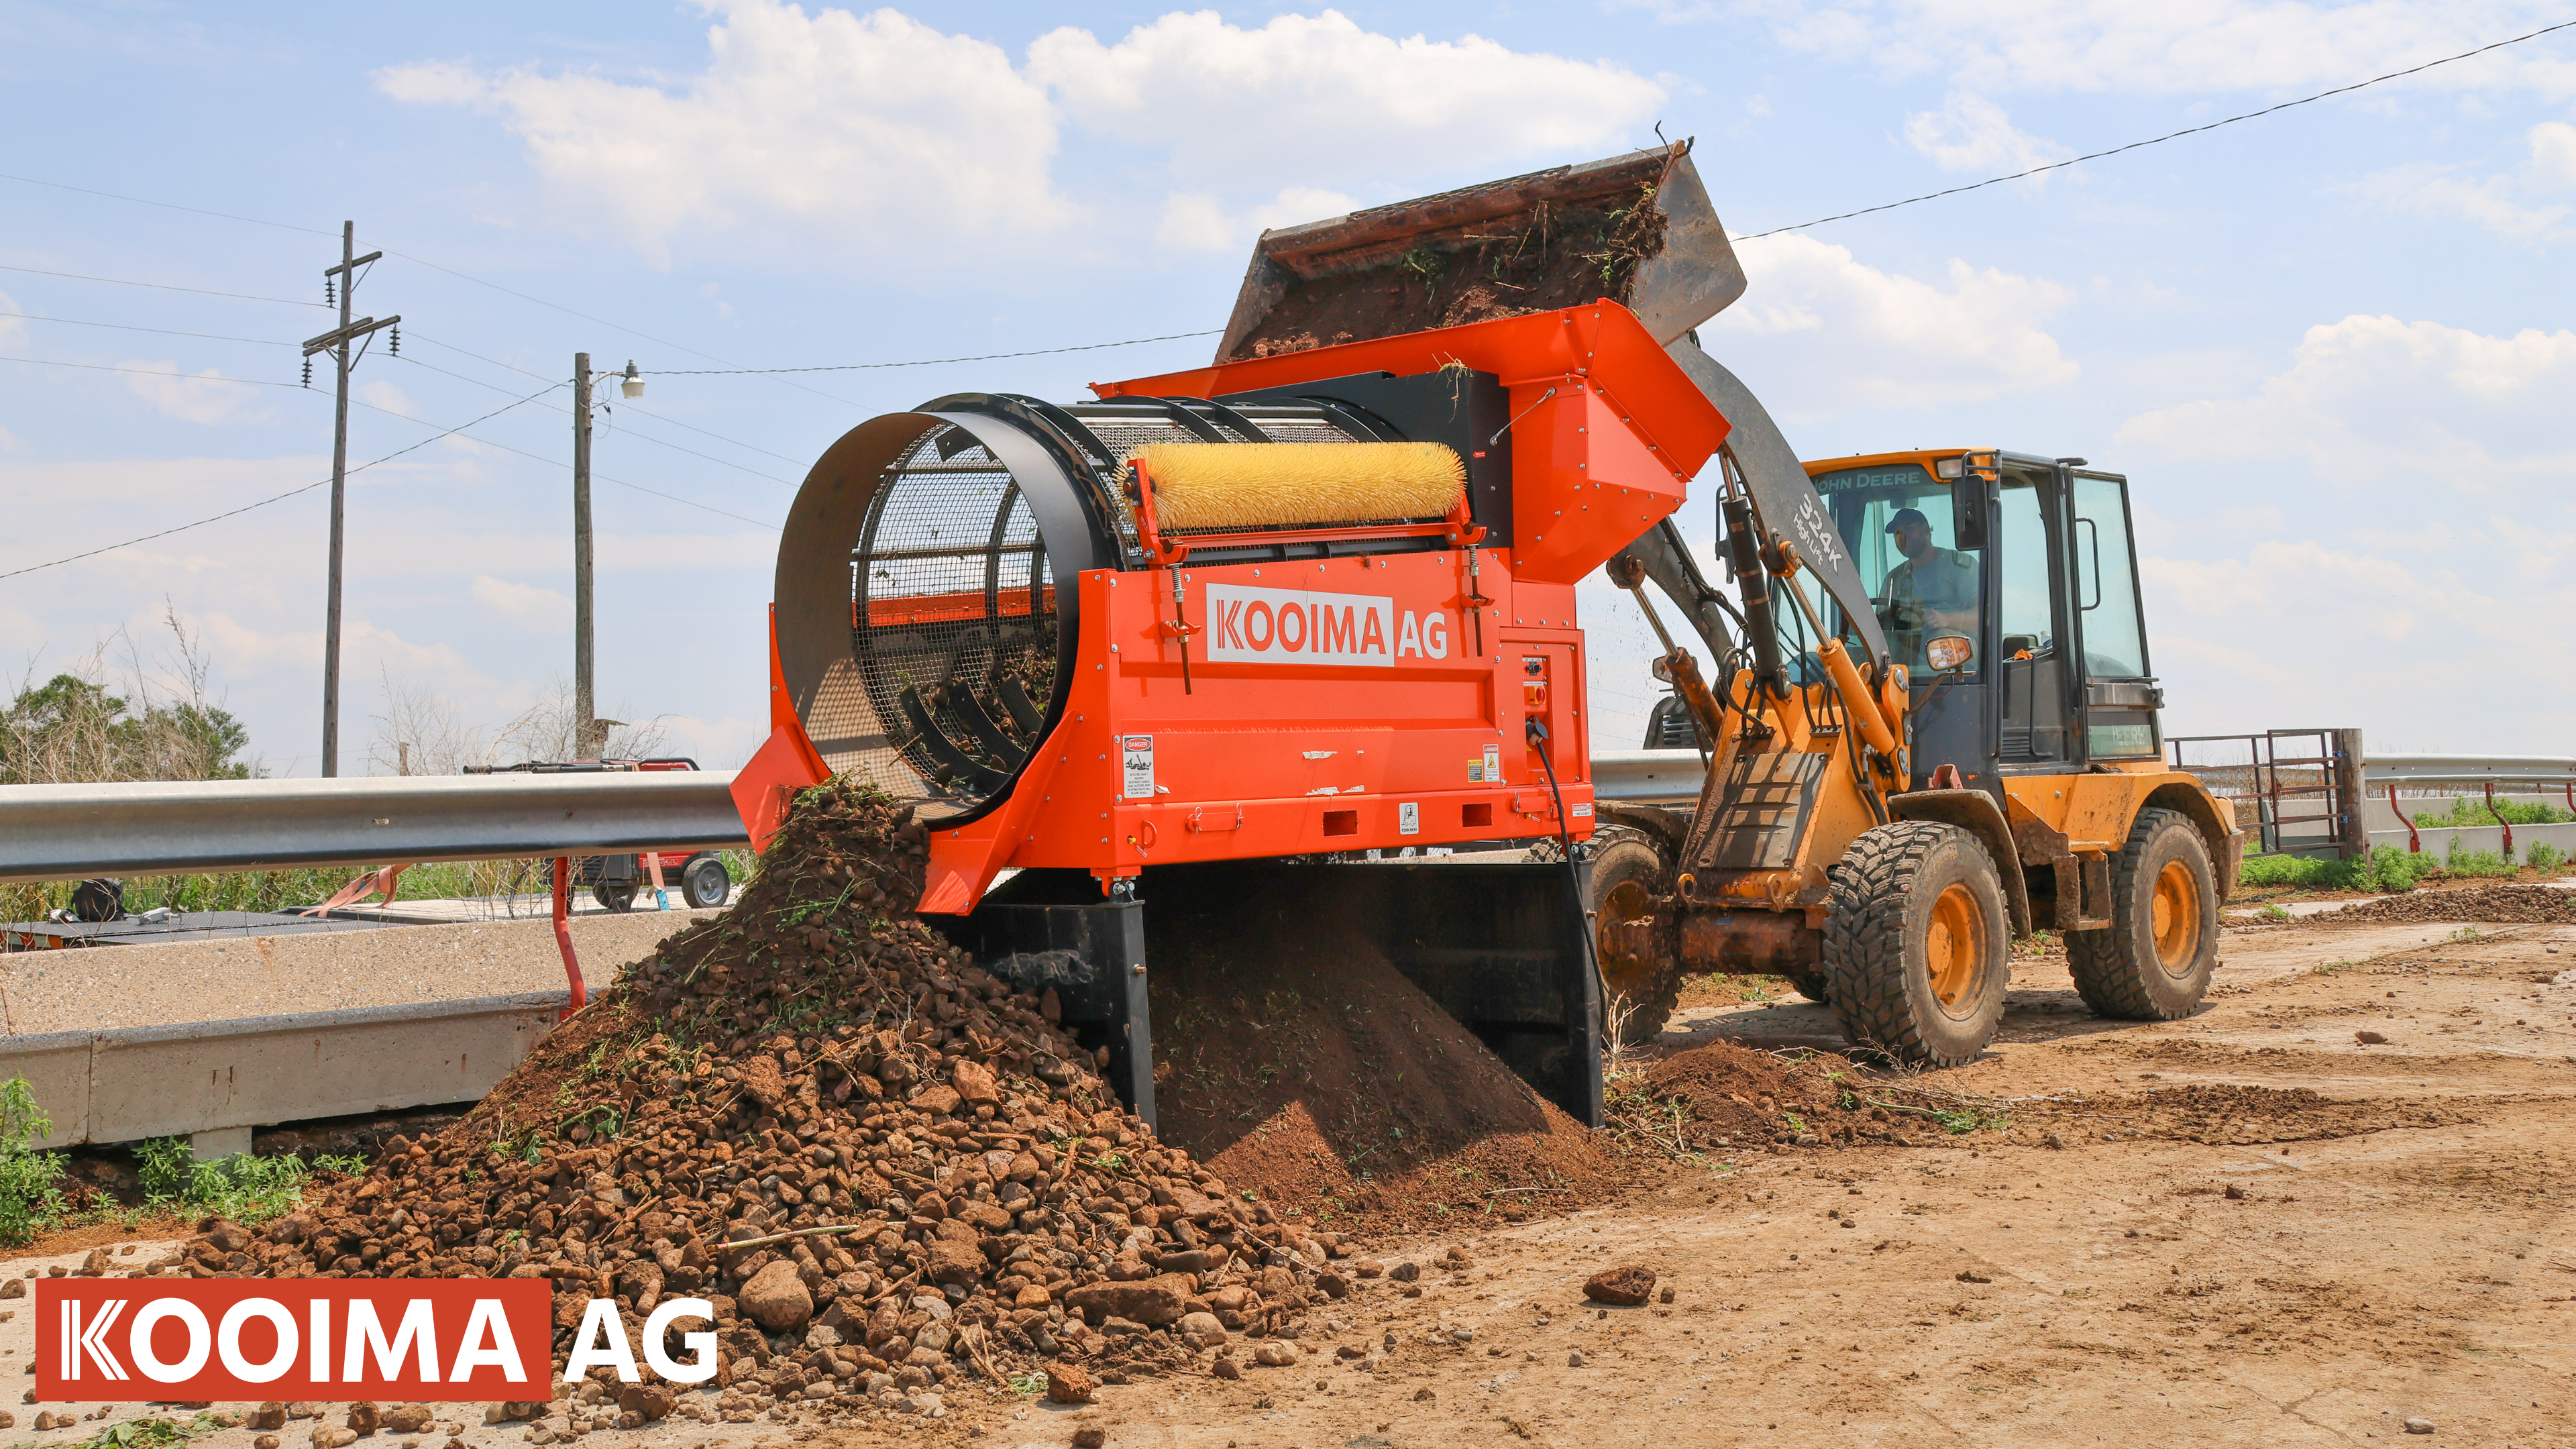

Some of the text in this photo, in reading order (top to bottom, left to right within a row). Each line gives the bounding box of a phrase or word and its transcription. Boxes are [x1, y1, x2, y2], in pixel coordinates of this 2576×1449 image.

[1856, 472, 1920, 488] DEERE
[1793, 513, 1823, 566] High Lift
[1799, 492, 1843, 574] 324K
[1216, 599, 1448, 659] KOOIMA AG
